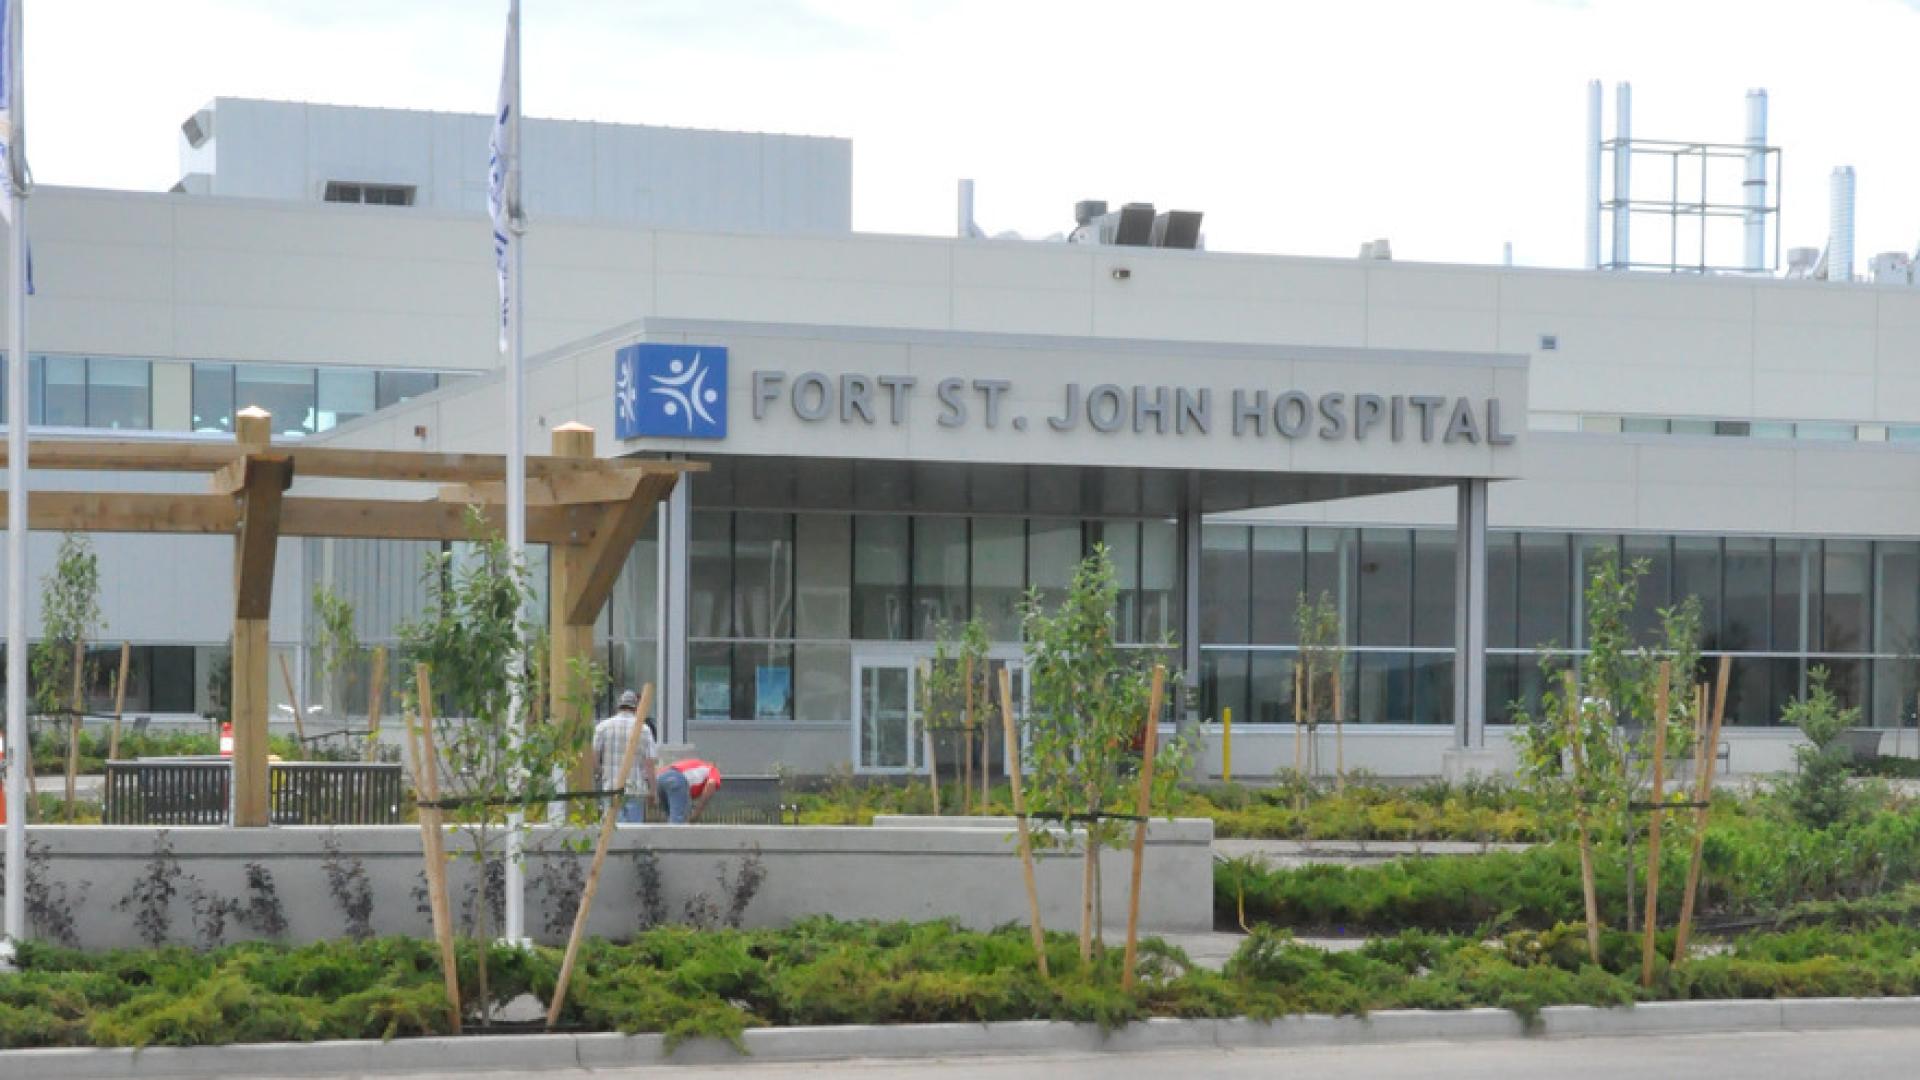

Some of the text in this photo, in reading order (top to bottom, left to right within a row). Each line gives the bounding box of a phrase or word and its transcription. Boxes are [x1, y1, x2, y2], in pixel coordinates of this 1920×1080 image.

[752, 370, 1517, 446] FORT ST. JOHN HOSPITAL
